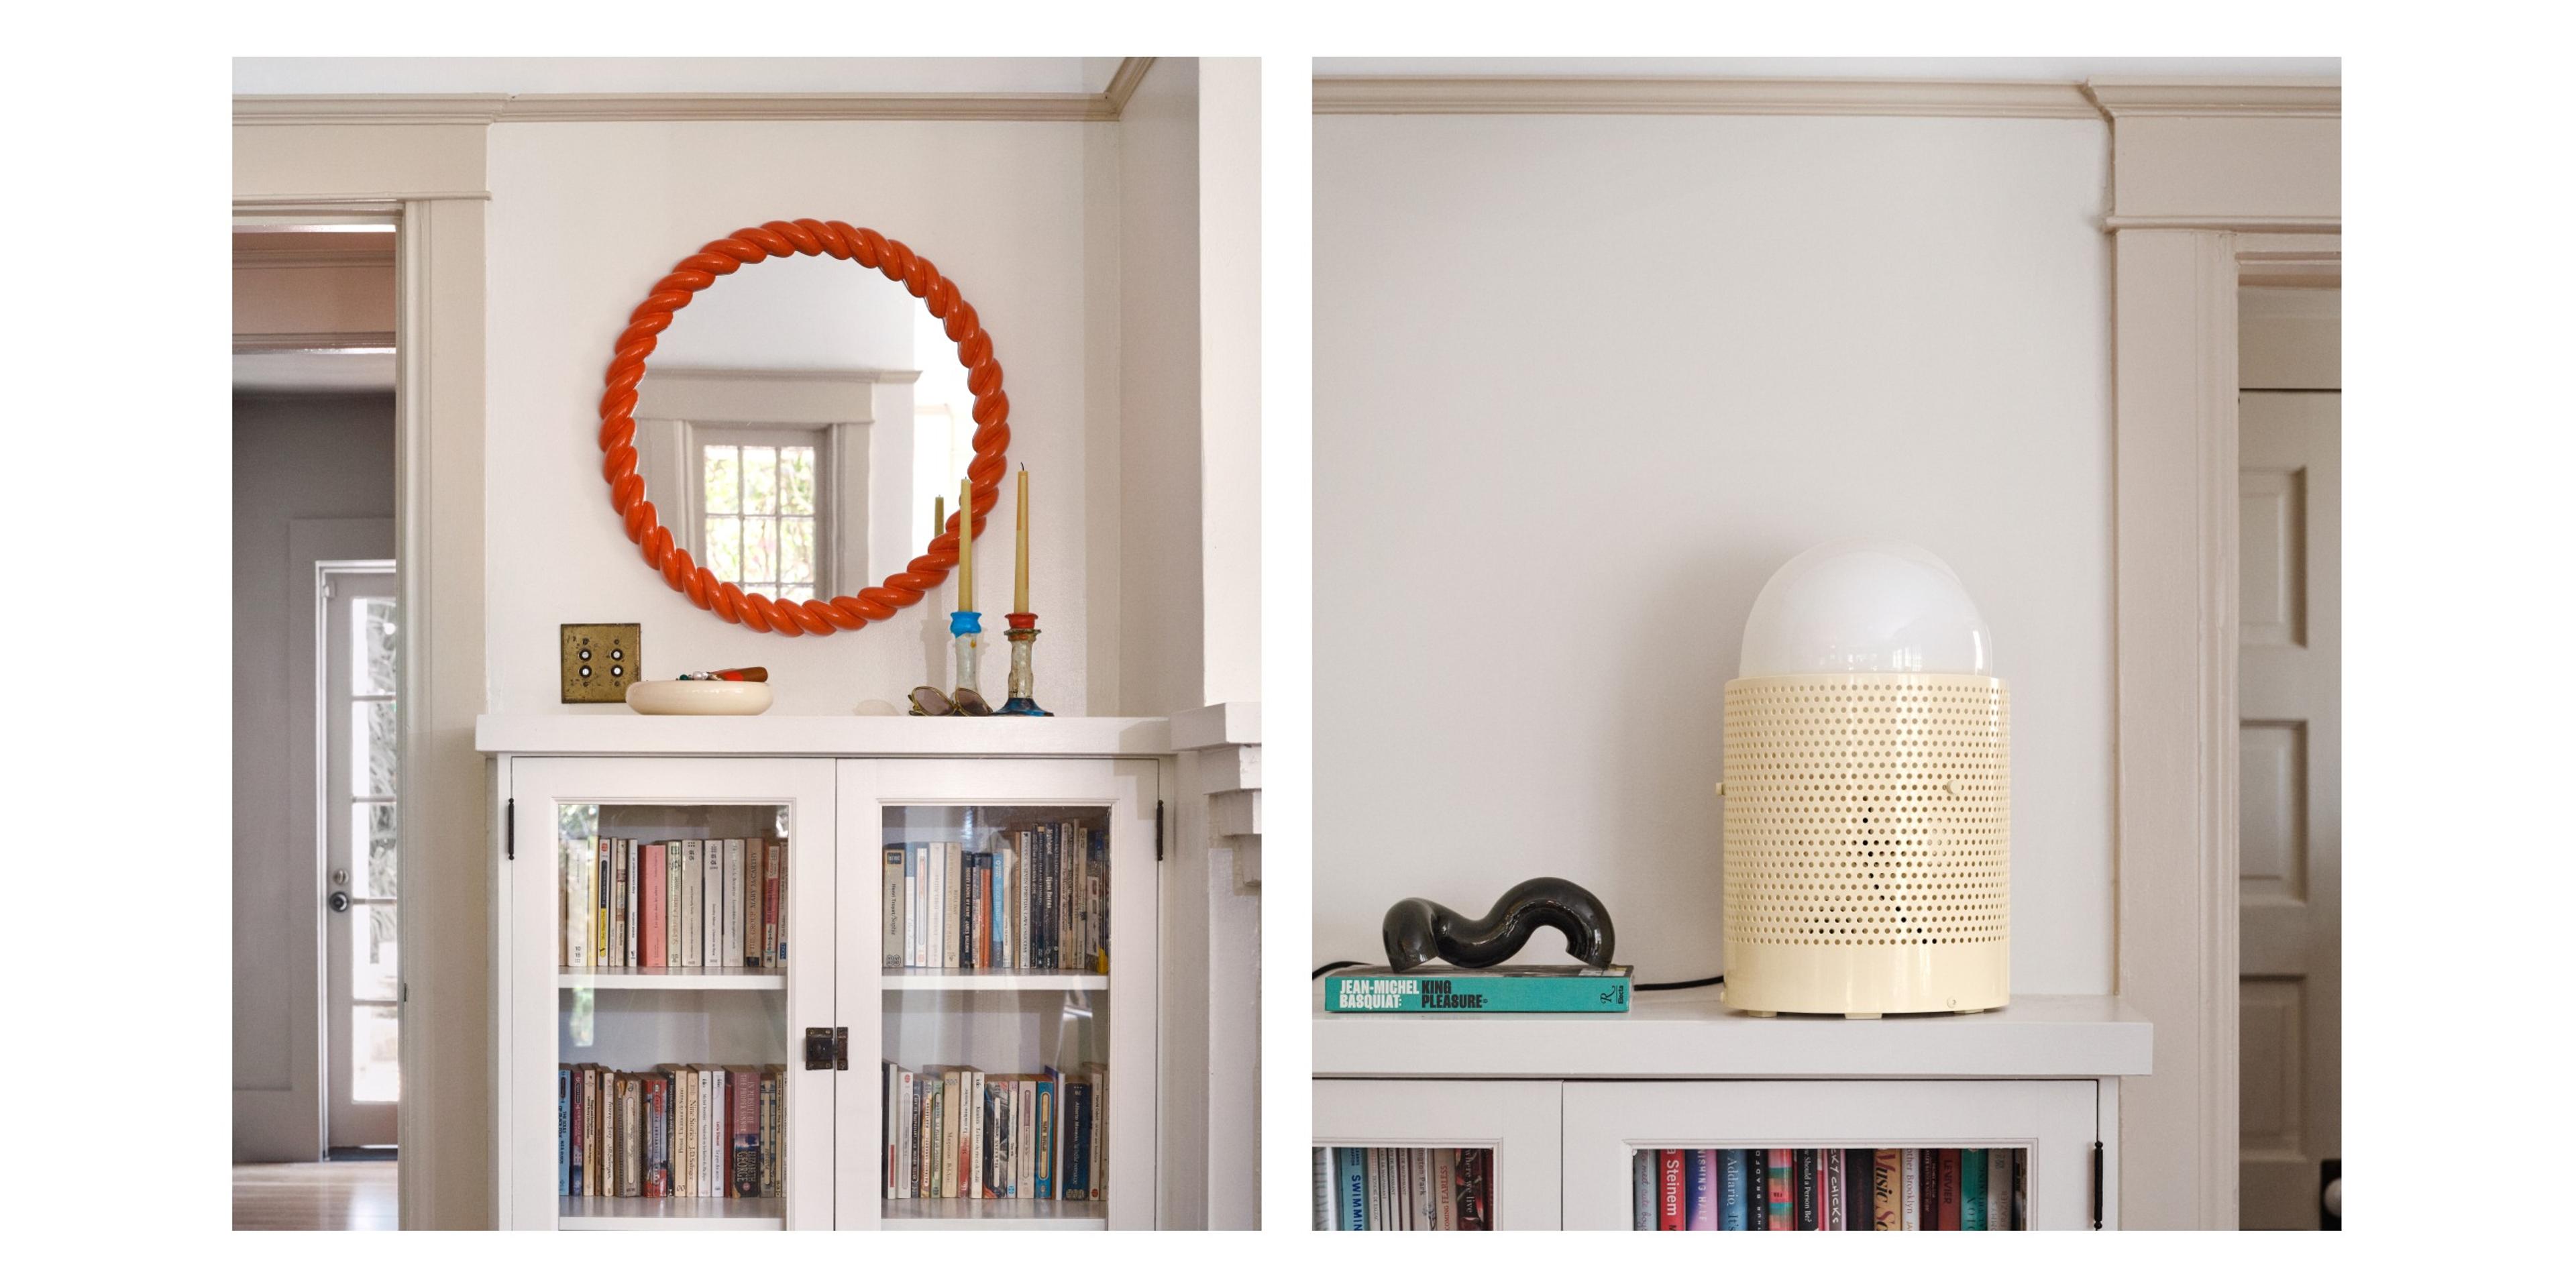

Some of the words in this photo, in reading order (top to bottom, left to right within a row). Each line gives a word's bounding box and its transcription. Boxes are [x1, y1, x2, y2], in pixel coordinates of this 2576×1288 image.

[1340, 980, 1419, 994] JEAN-MICHEL
[1421, 980, 1452, 994] KING
[1340, 994, 1402, 1009] BASQUIAT:
[737, 1151, 747, 1181] GEORGE
[1803, 1157, 1811, 1180] Should
[1876, 1150, 1896, 1203] Music
[1440, 1165, 1449, 1203] FEARLESS
[1466, 1181, 1472, 1193] we
[1666, 1160, 1679, 1216] Steinem
[1905, 1175, 1915, 1214] Brooklyn
[1352, 1175, 1362, 1231] SWIMMIN
[1466, 1196, 1475, 1213] live
[1698, 1196, 1707, 1222] HALF
[1831, 1176, 1841, 1224] CHICKS
[1805, 1210, 1813, 1223] Be?
